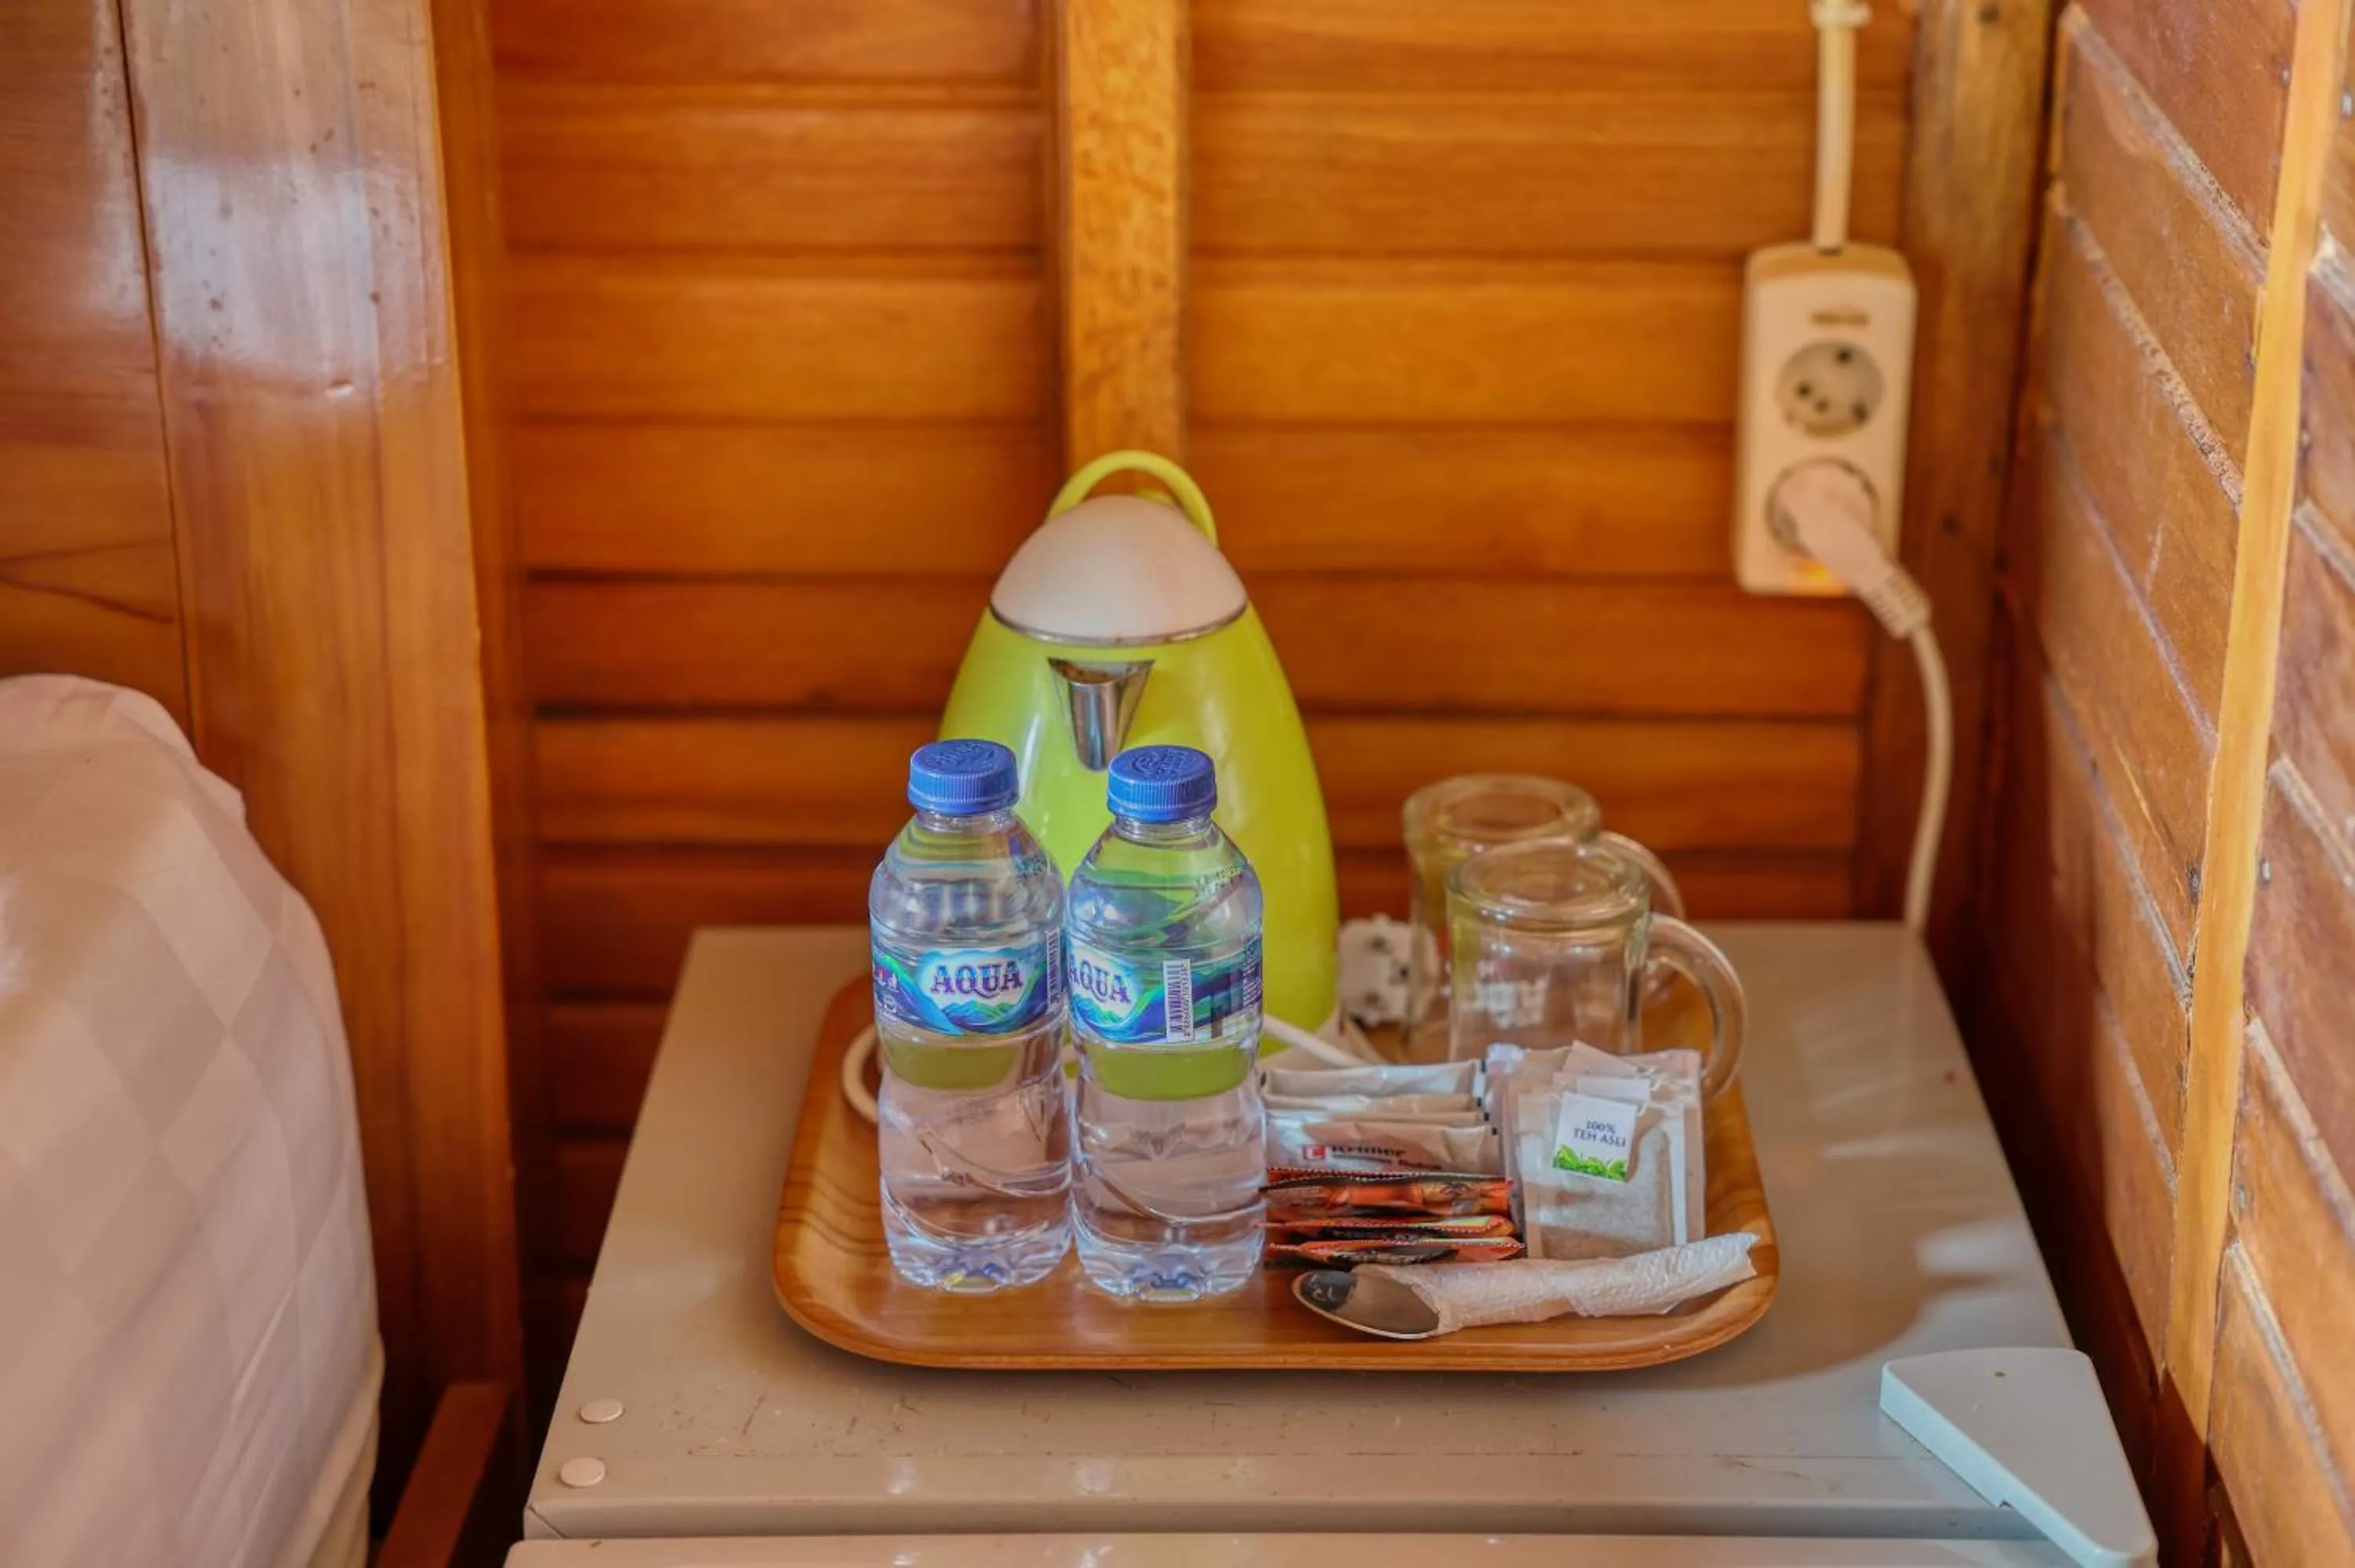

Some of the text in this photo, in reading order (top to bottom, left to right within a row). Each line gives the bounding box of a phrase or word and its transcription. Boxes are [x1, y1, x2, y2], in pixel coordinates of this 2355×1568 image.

[930, 961, 1023, 999] AQUA
[1067, 954, 1132, 1004] AQUA
[1574, 1128, 1627, 1147] TEH ASLI
[1586, 1120, 1616, 1134] 100%
